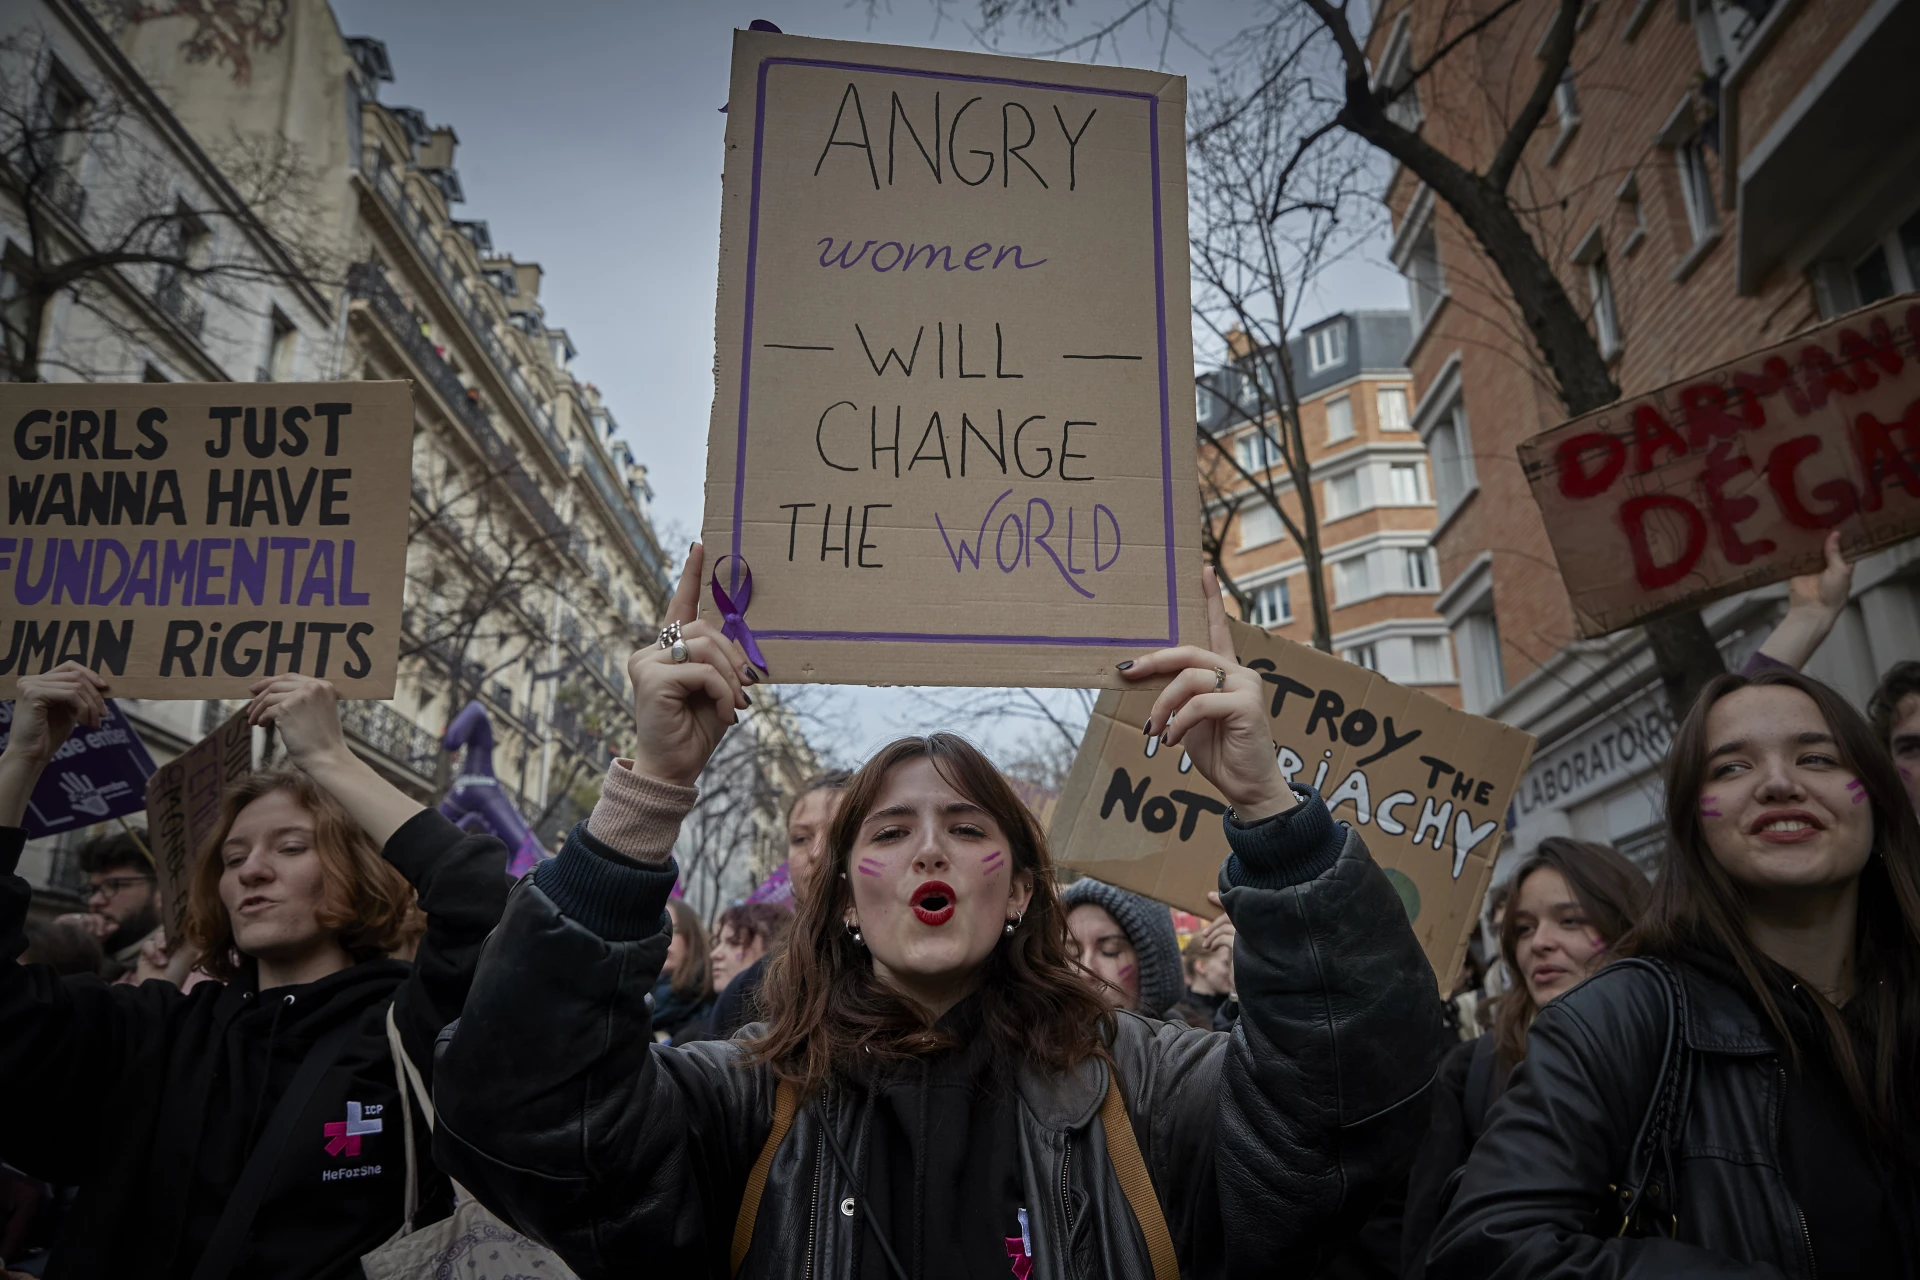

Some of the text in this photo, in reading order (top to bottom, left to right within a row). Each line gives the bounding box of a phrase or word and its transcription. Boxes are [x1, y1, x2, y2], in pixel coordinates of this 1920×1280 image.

[813, 83, 1097, 191] ANGRY
[817, 235, 1048, 273] women
[854, 322, 1024, 379] WILL
[205, 403, 352, 459] JUST
[815, 400, 1097, 481] CHANGE
[9, 467, 352, 527] WANNA HAVE
[779, 488, 1122, 599] THE WORLD
[0, 619, 134, 676] UMAN
[1419, 755, 1494, 805] THE
[364, 1105, 384, 1115] ICP
[322, 1164, 382, 1181] HeForShe
